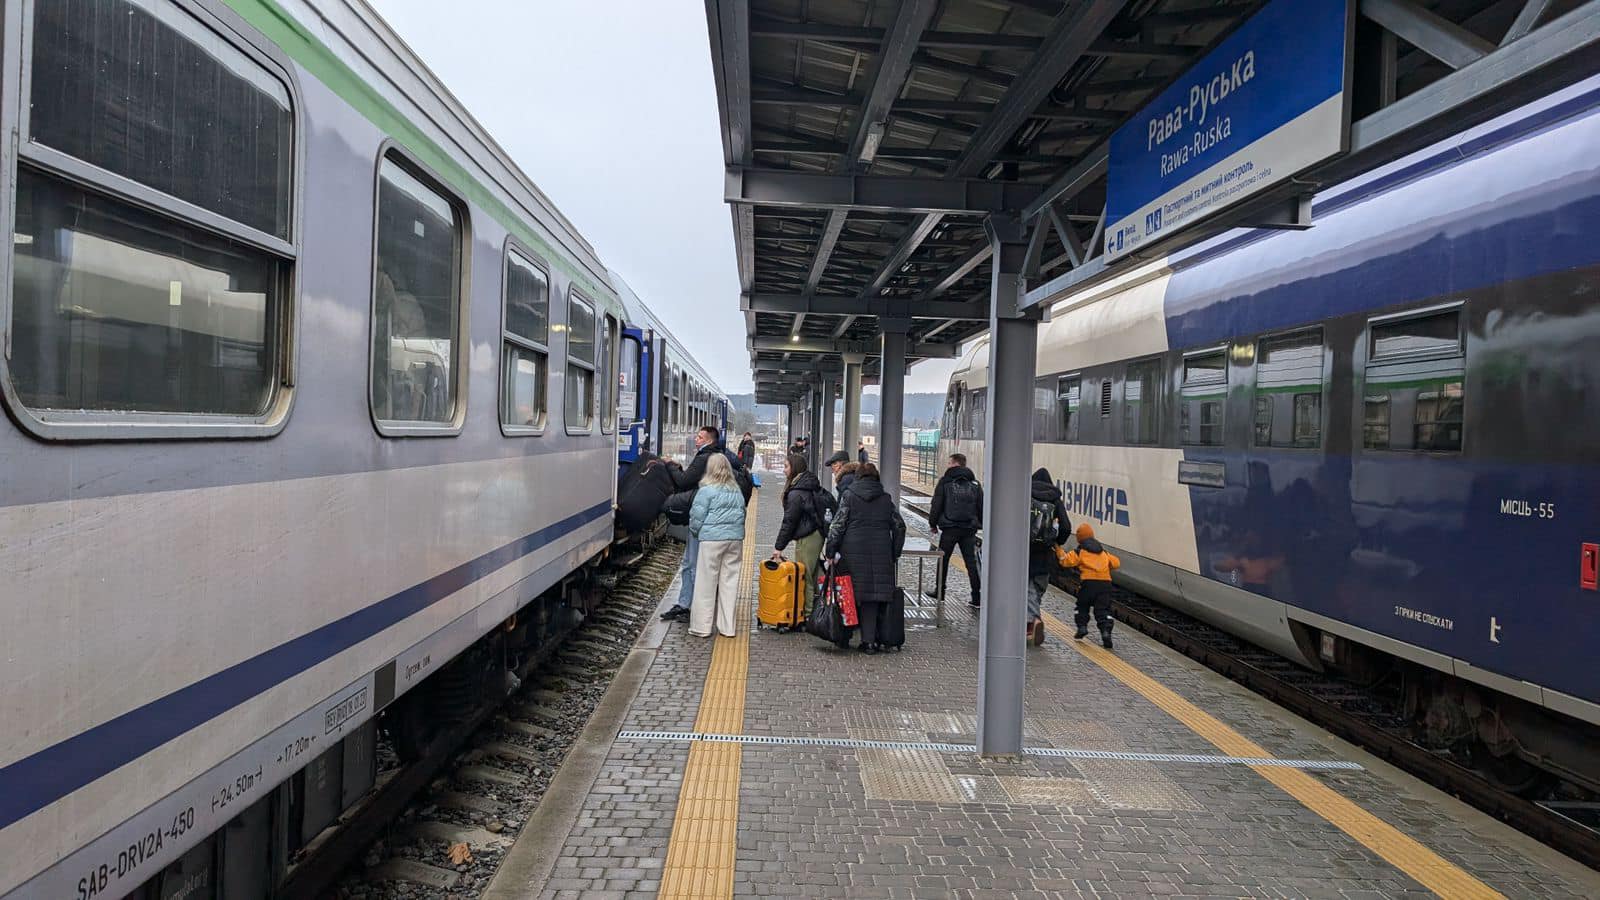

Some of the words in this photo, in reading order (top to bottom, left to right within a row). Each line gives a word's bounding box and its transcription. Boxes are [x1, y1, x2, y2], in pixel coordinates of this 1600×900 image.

[1148, 50, 1256, 152] Рава-Руська
[1161, 116, 1231, 178] Rawa-Ruska
[1224, 161, 1254, 183] контроль
[77, 806, 194, 900] SAB-DRV2A-450
